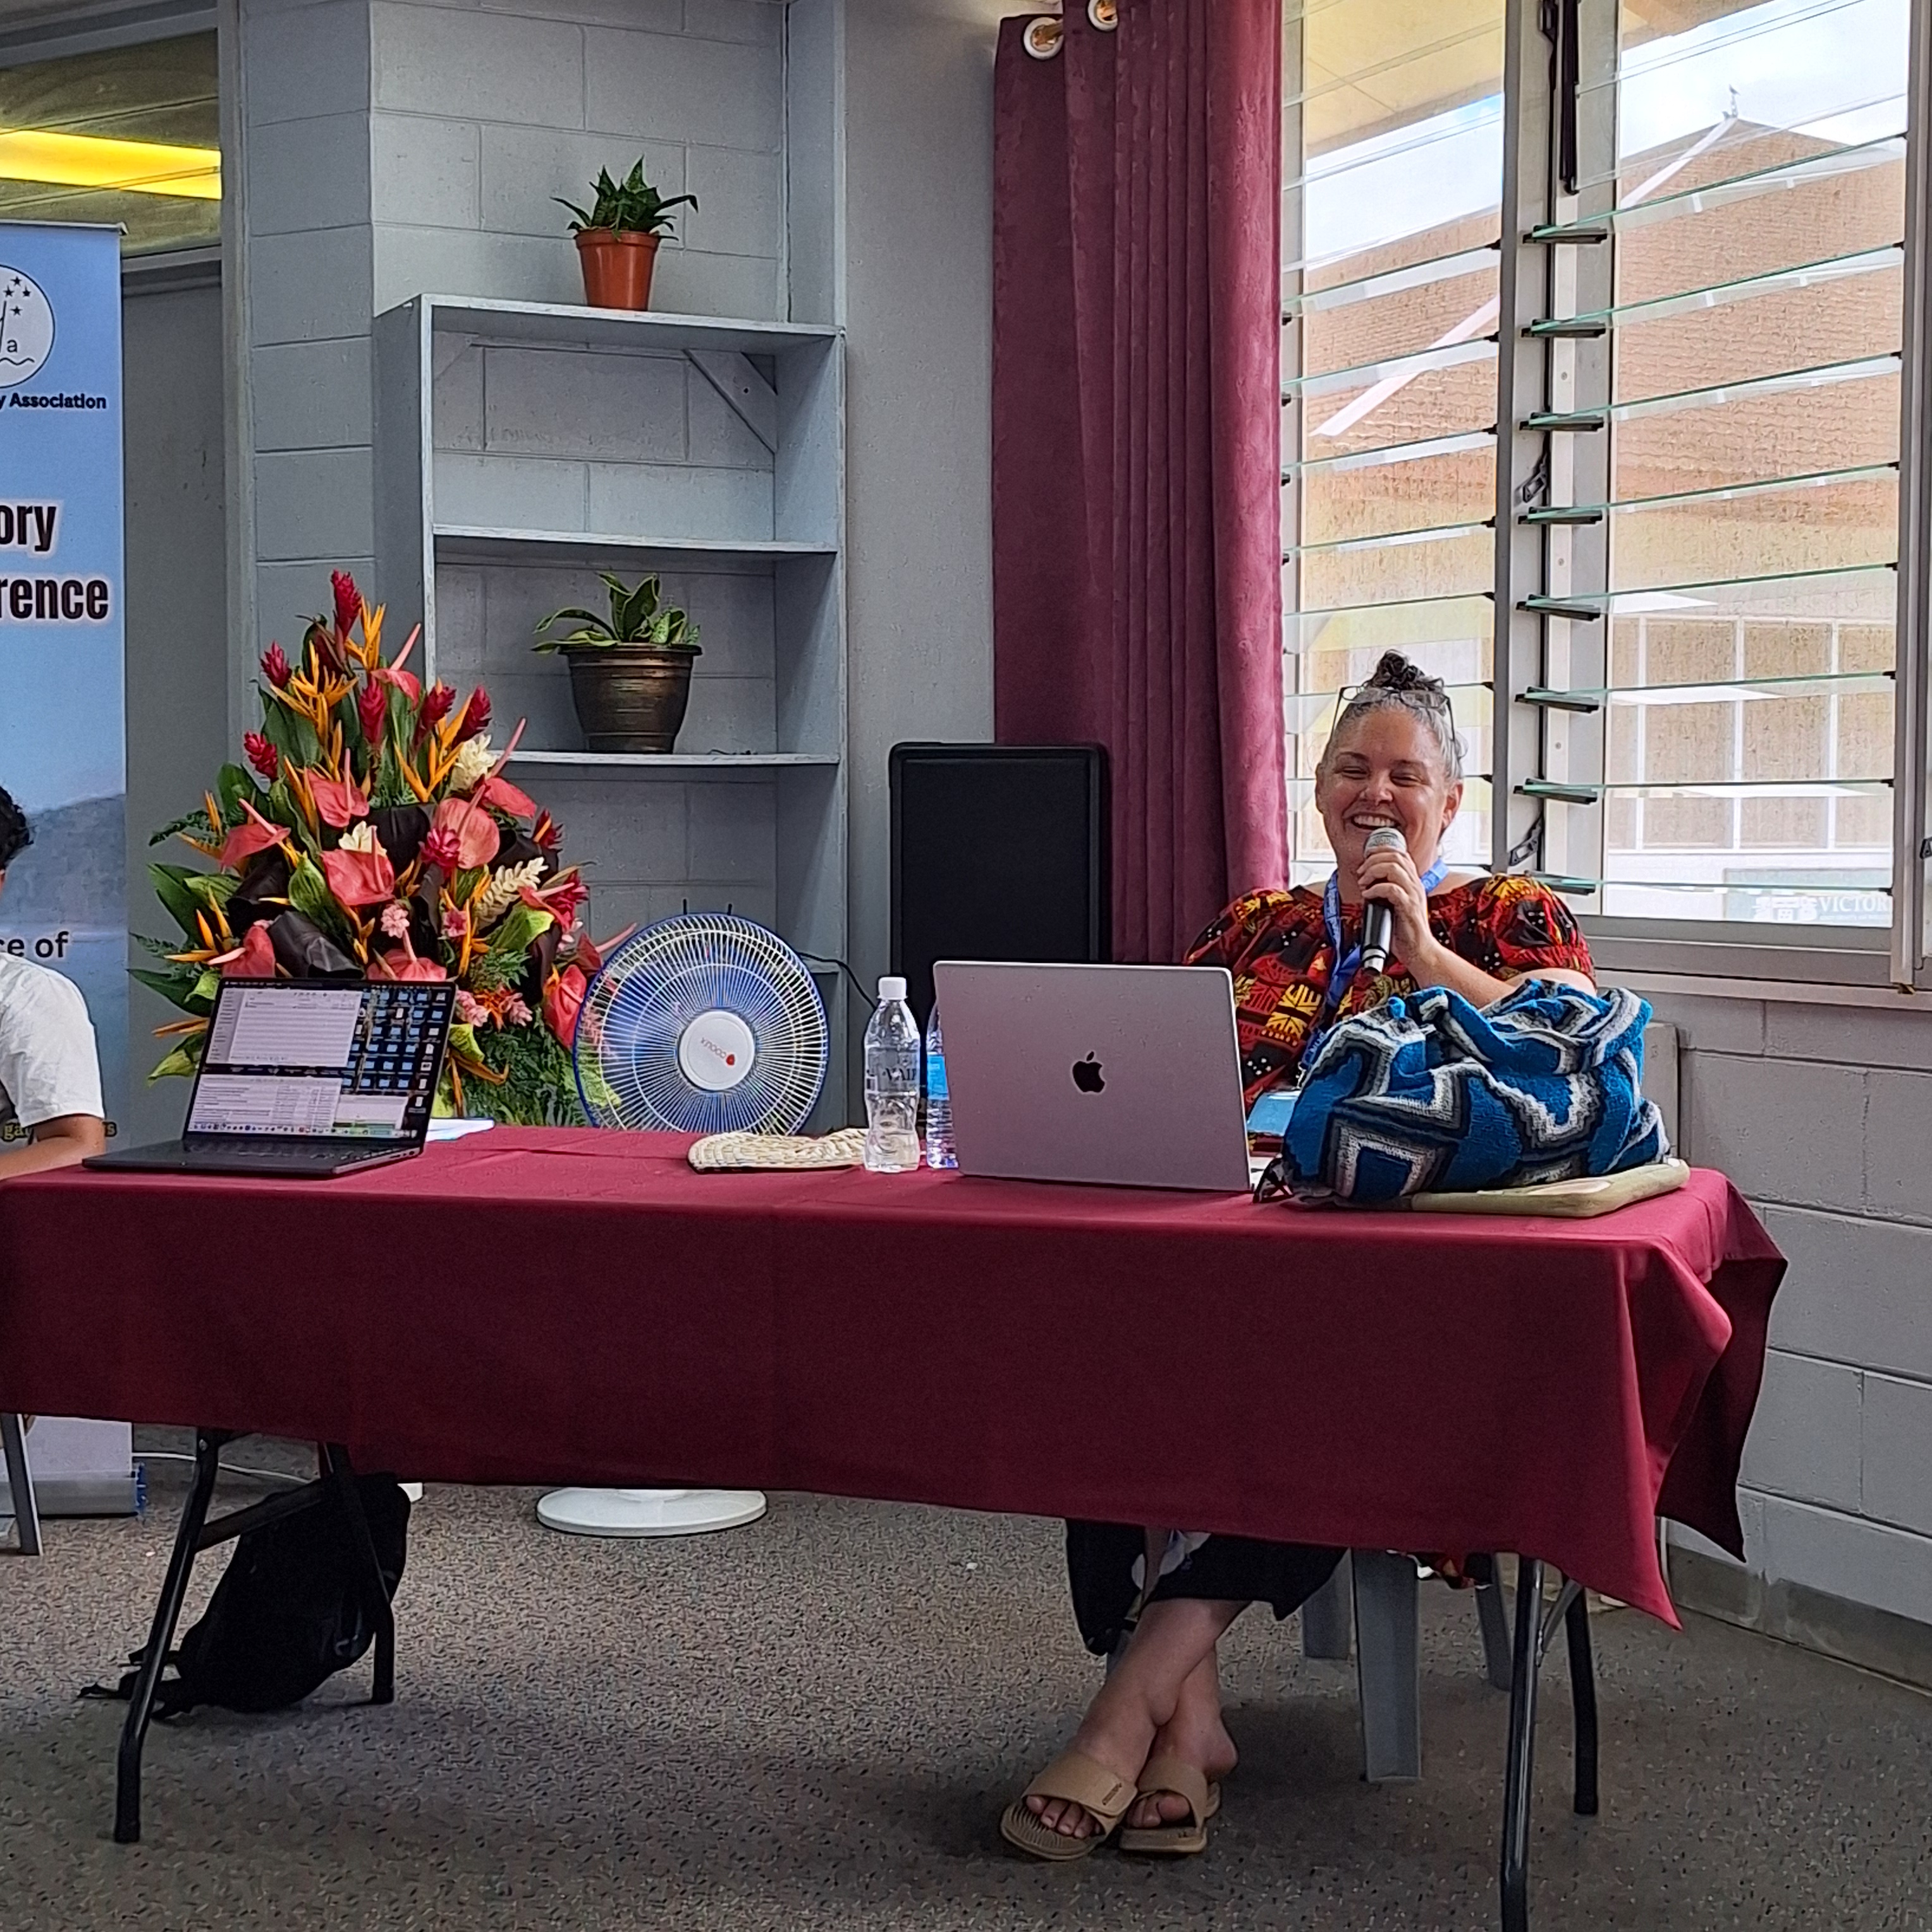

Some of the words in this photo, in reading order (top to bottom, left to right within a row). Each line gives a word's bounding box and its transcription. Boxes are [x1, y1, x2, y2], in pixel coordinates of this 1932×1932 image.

[7, 339, 18, 353] a
[9, 393, 106, 409] Association
[0, 505, 57, 552] ory
[35, 931, 69, 958] of
